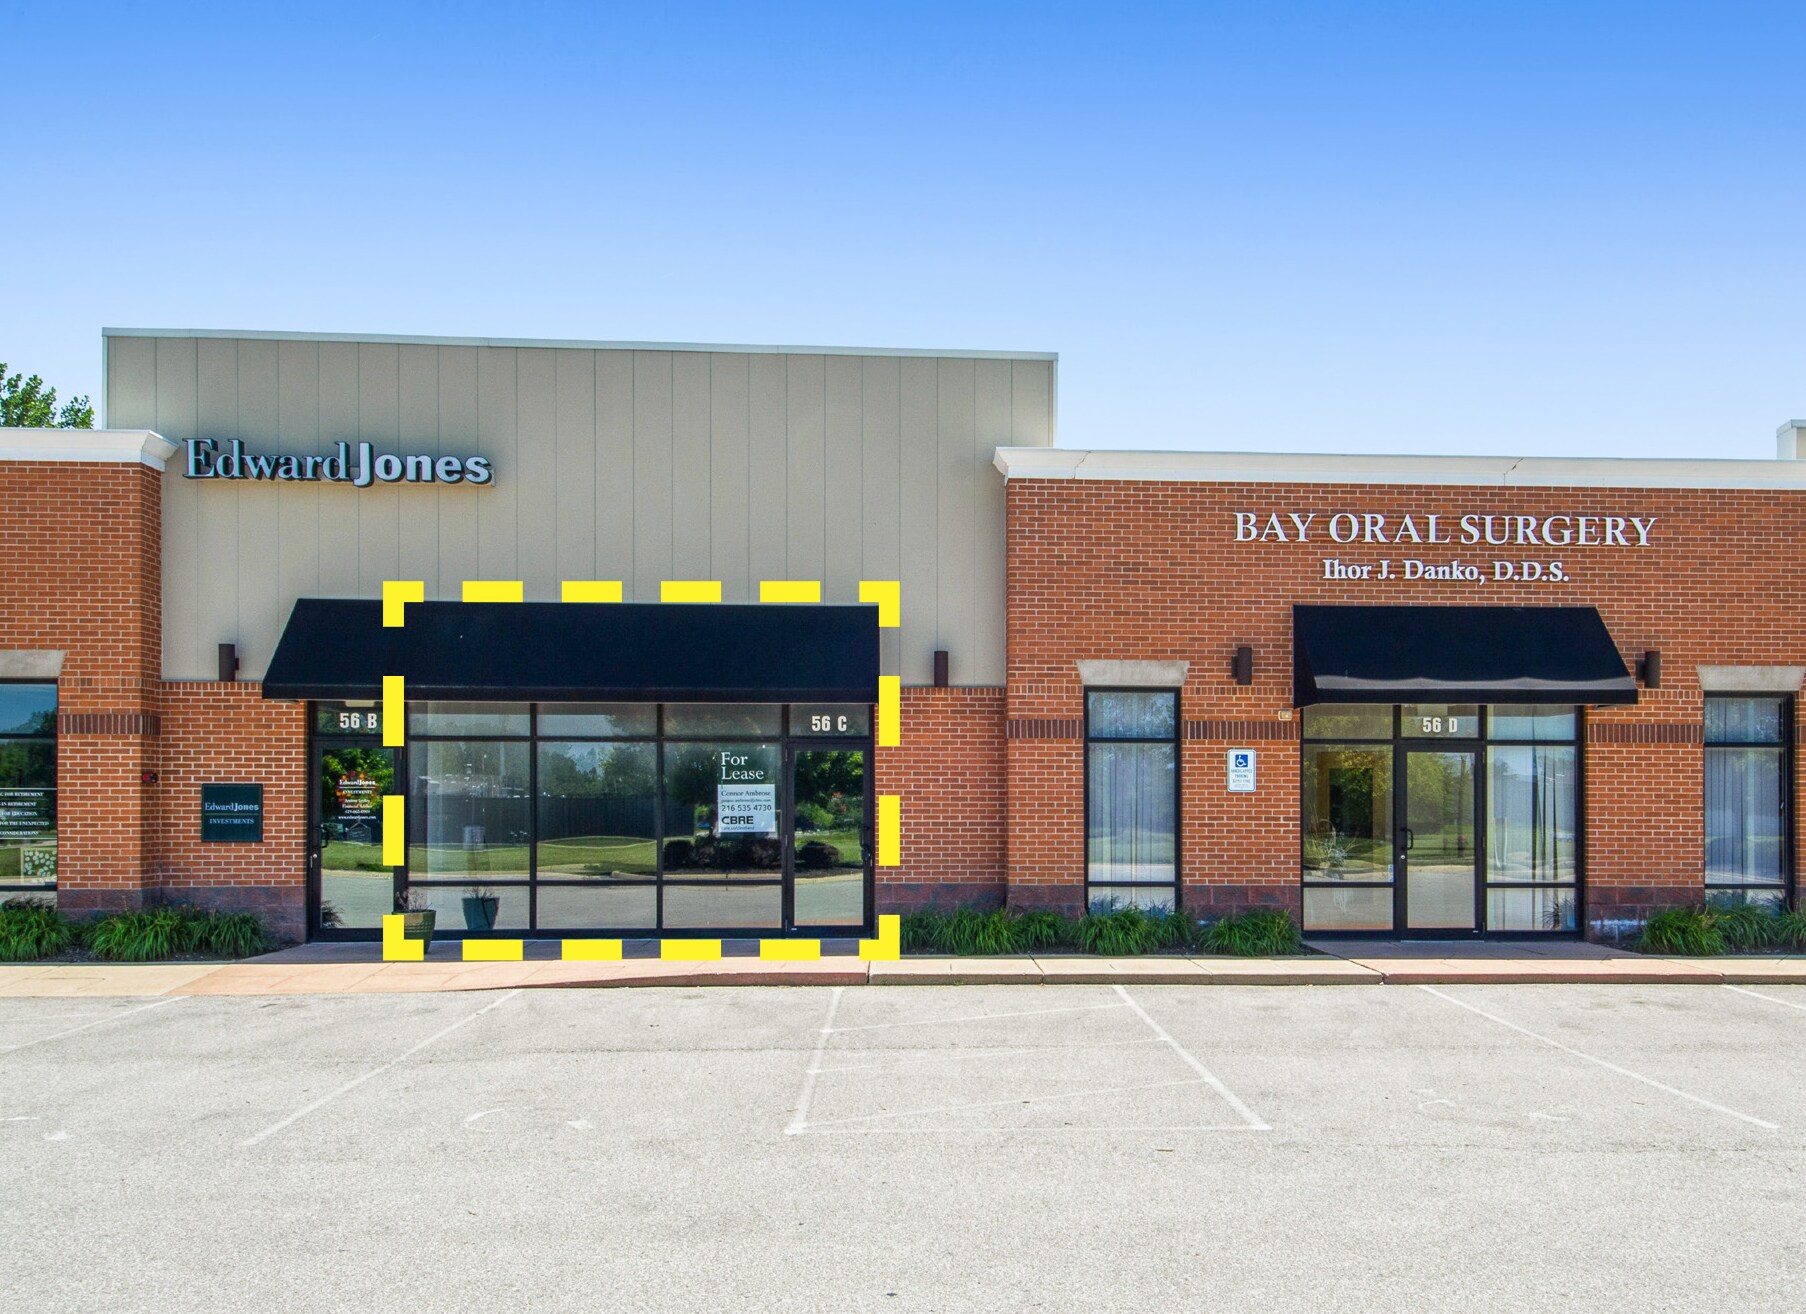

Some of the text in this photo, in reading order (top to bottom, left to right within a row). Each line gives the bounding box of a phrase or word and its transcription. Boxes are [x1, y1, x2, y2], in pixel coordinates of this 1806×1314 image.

[1232, 512, 1659, 547] BAY ORAL SURGERY
[1322, 559, 1570, 585] Ihor J. Danko, D.D.S.
[340, 712, 378, 729] 56 B
[811, 715, 847, 732] 56 C
[1422, 717, 1458, 733] 56 D
[720, 752, 748, 766] For
[721, 766, 765, 780] Lease
[721, 816, 754, 825] CBRE
